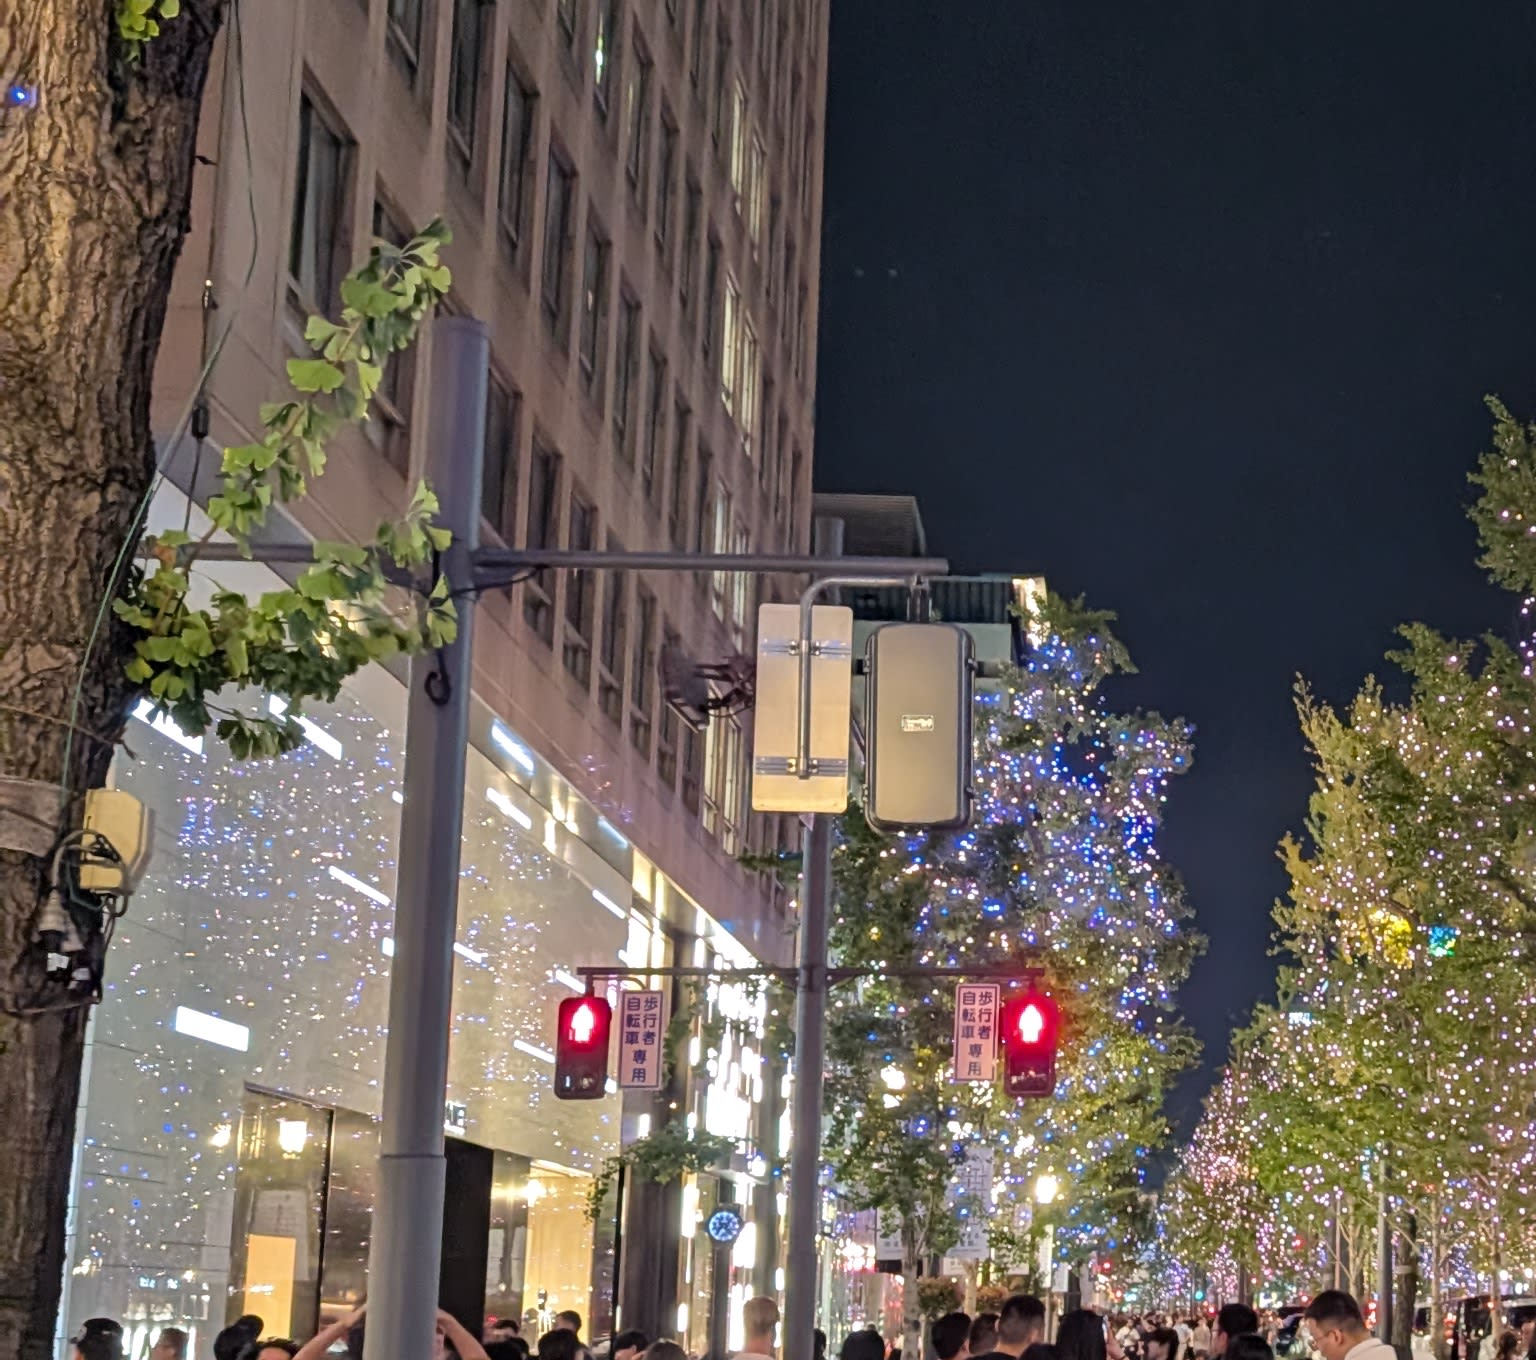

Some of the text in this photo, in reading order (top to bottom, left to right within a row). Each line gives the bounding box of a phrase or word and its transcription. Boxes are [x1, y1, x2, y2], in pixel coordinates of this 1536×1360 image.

[625, 996, 641, 1045] 自転車
[643, 996, 658, 1045] 歩行者
[961, 991, 976, 1039] 自転車
[980, 991, 993, 1040] 歩行者
[631, 1049, 647, 1083] 専用
[967, 1043, 982, 1076] 専用
